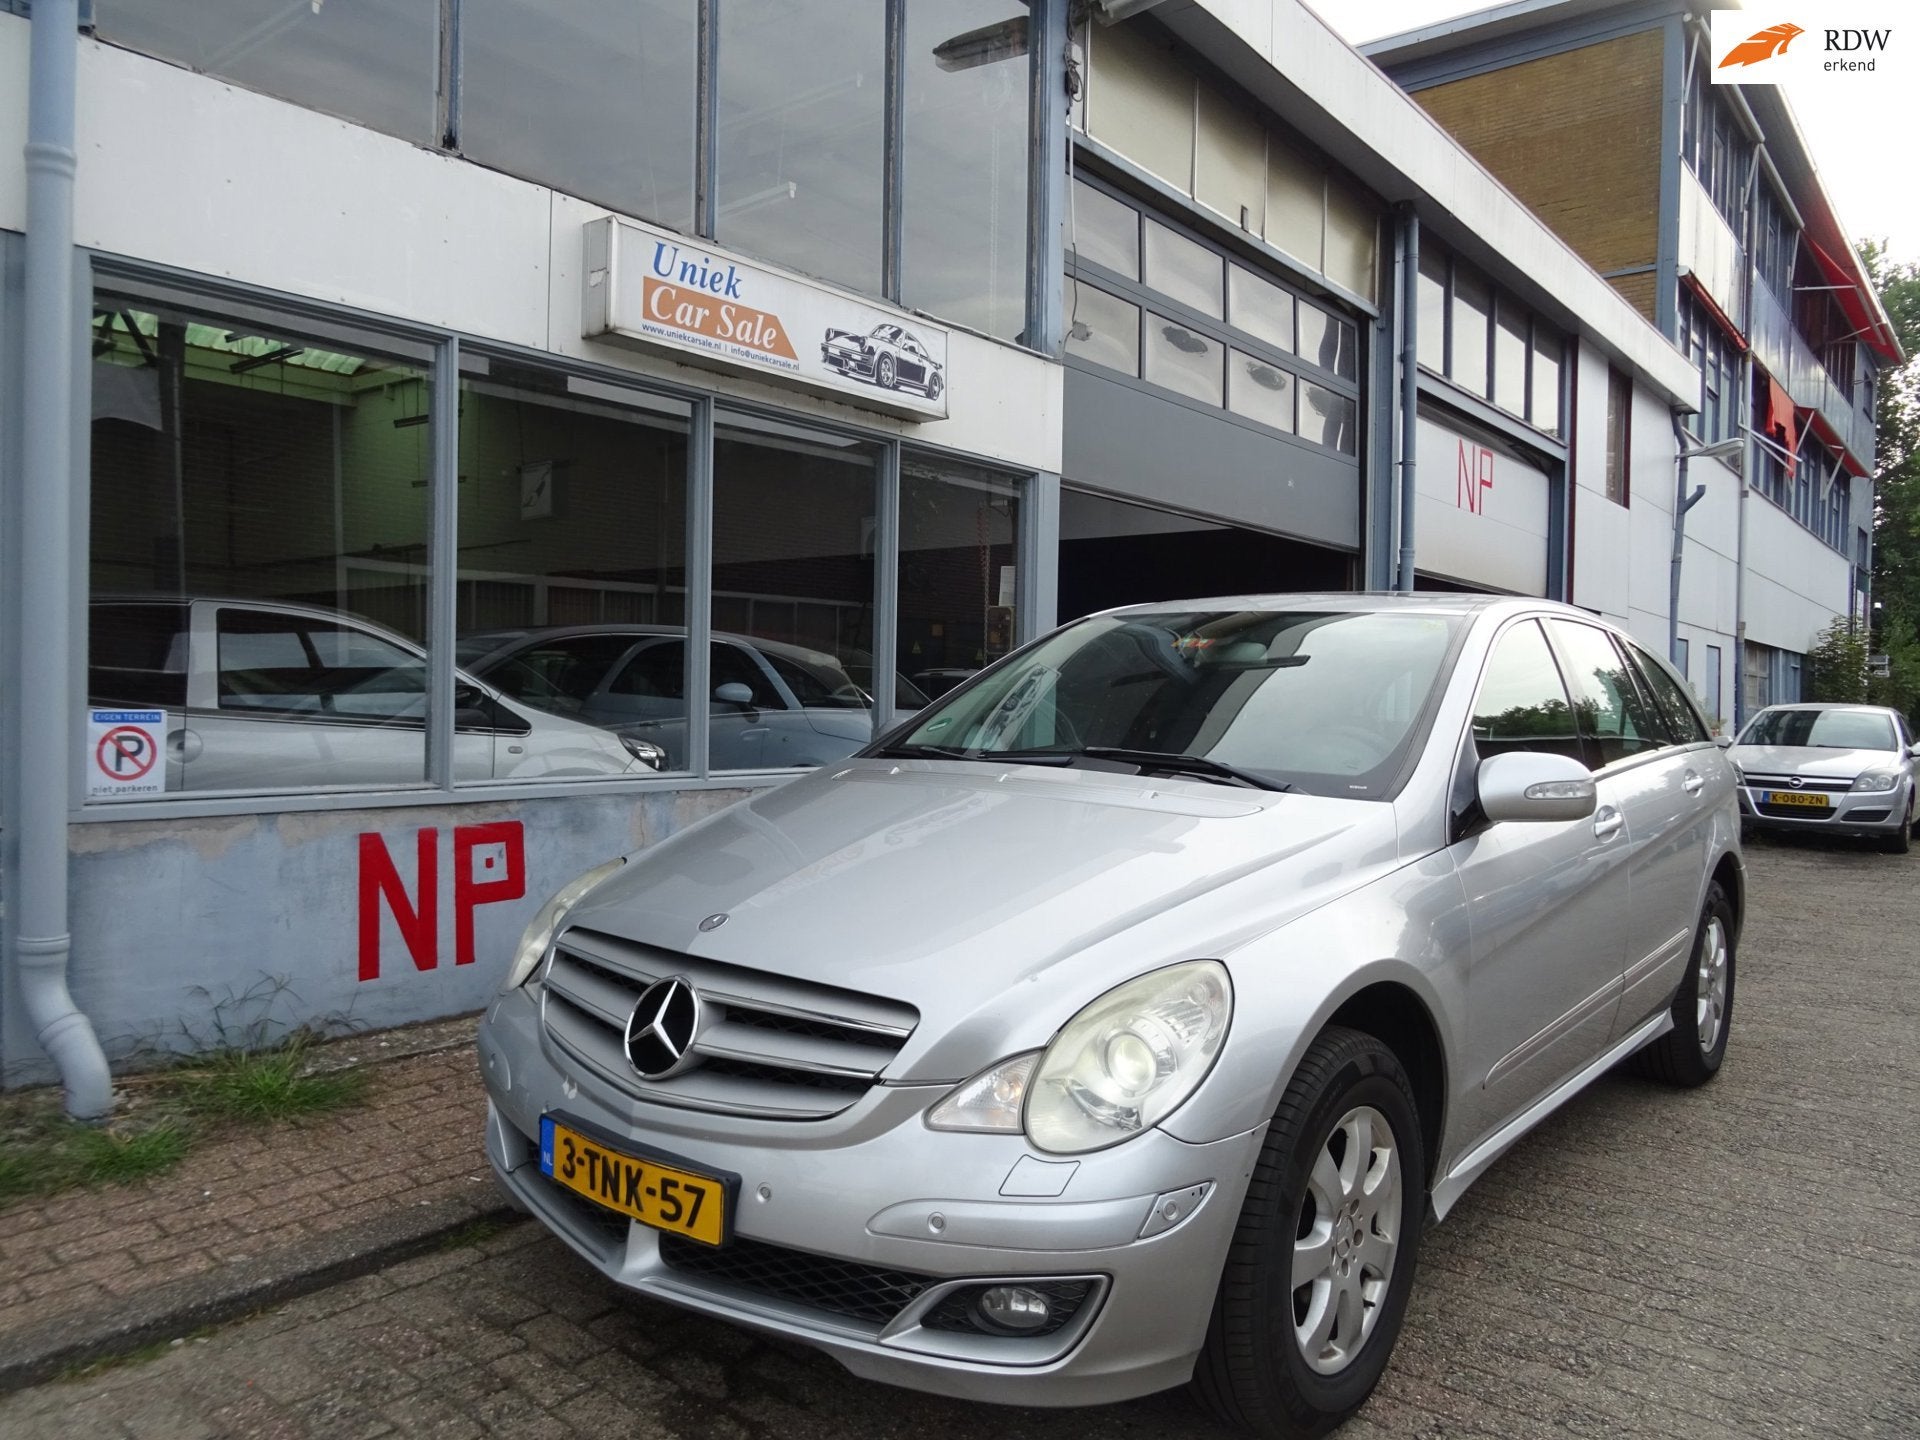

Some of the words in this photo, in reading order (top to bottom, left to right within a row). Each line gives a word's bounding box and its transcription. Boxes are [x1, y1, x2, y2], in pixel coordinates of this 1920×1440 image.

[653, 241, 742, 299] Uniek
[642, 323, 722, 351] www.uniekcarsale.nl
[730, 345, 800, 371] info@uniekcarsale.nl
[650, 285, 710, 329] Car
[716, 304, 777, 350] Sale
[1457, 438, 1494, 516] NP
[94, 713, 121, 721] EIGEN
[124, 712, 160, 721] TERREIN
[115, 785, 158, 795] parkeren
[358, 820, 526, 982] NP
[562, 1137, 706, 1229] 3-TNK-57
